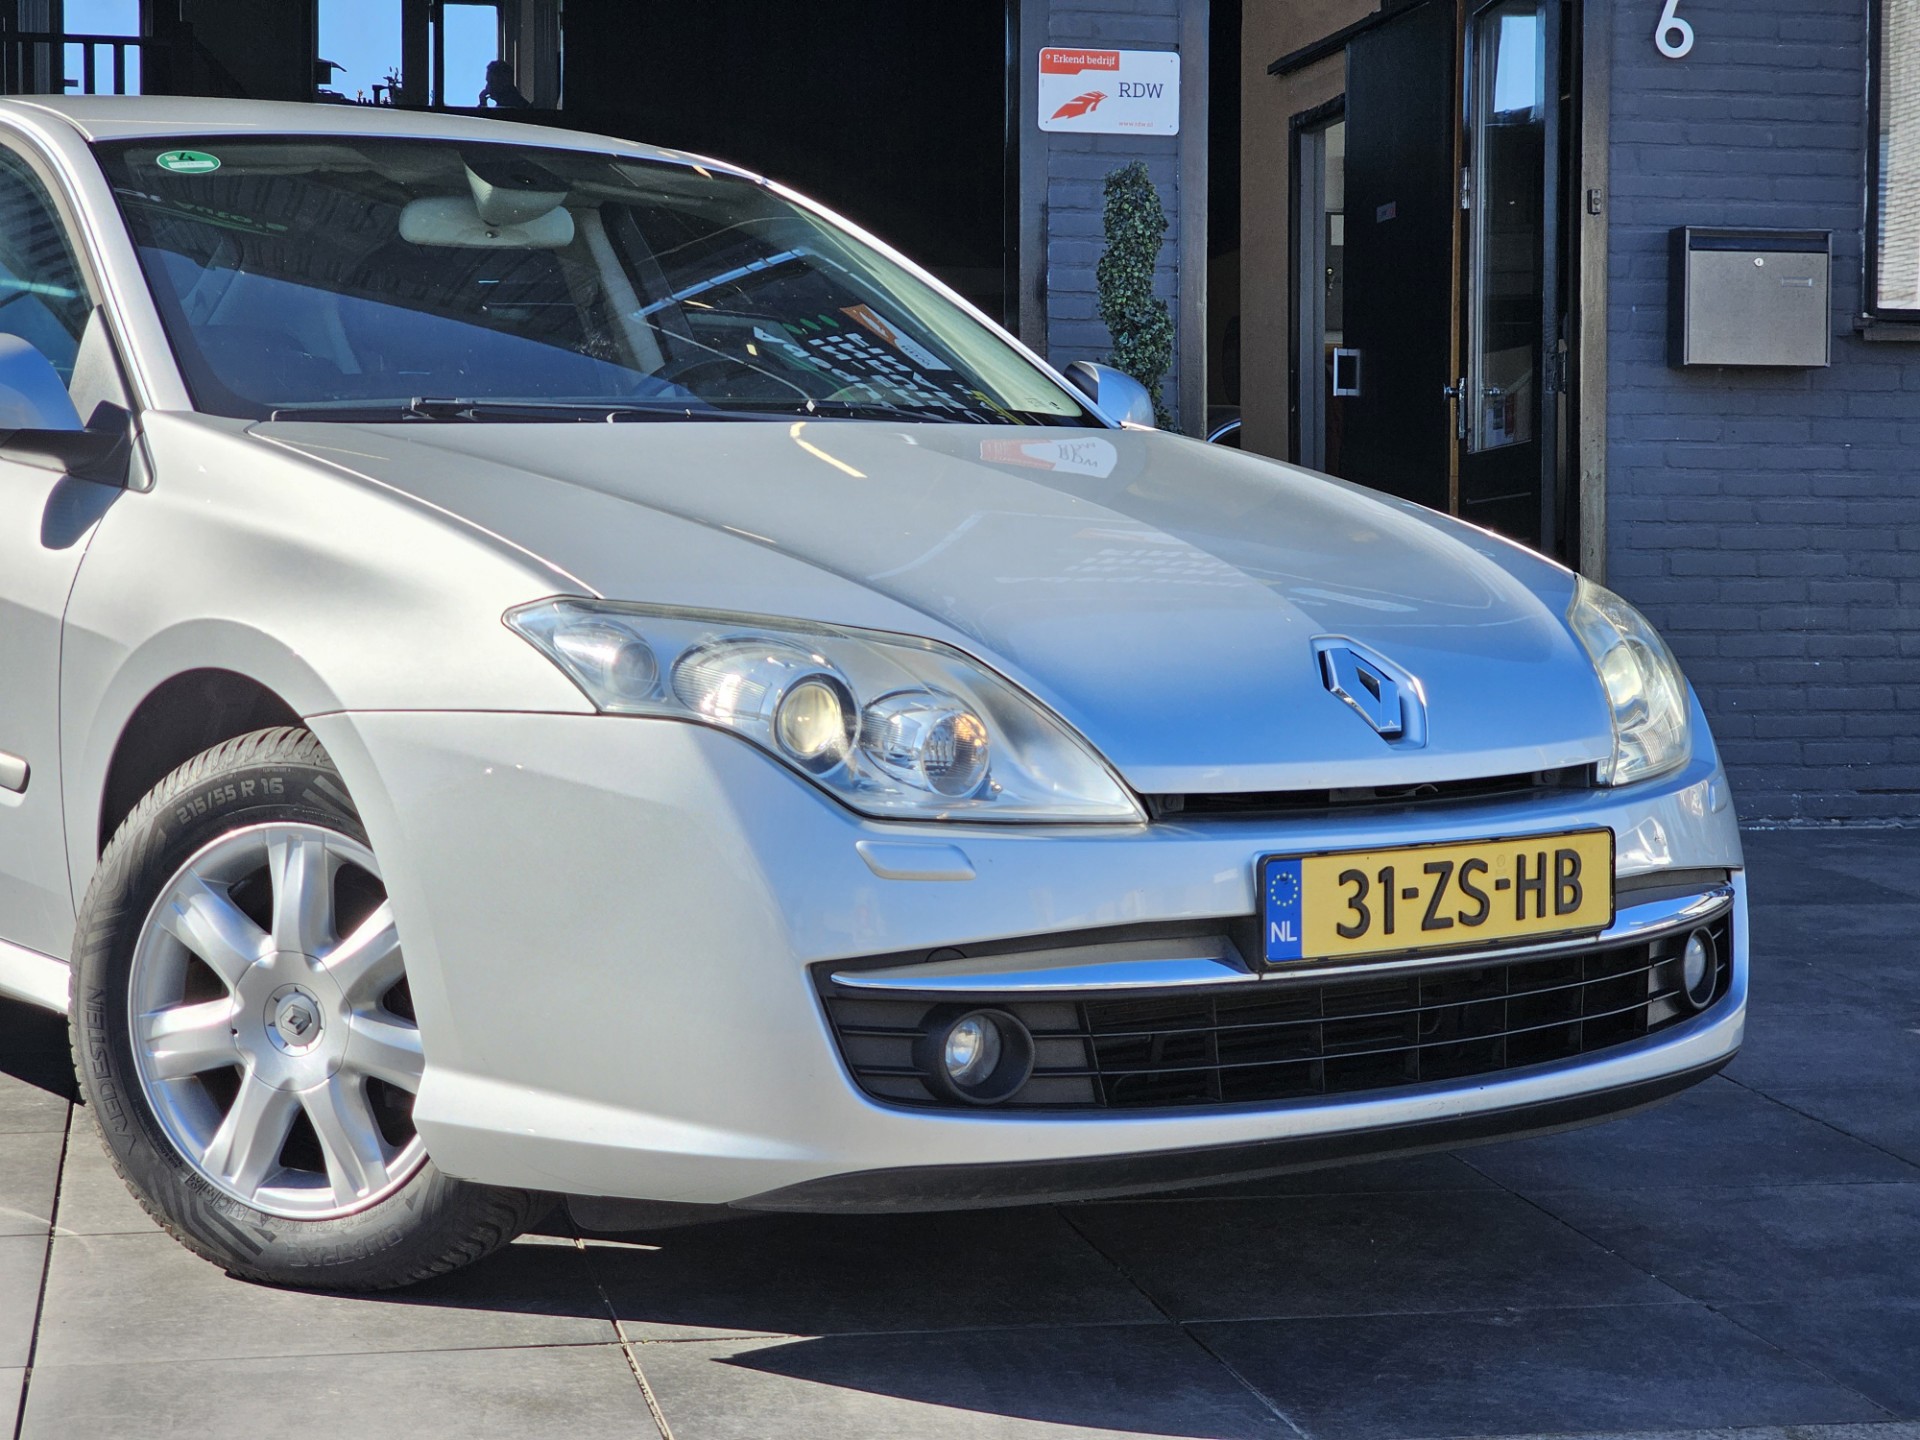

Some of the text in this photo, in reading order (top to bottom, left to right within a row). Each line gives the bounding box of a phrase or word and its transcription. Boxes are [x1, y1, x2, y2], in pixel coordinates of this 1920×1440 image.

[1655, 0, 1694, 59] 6
[1053, 54, 1116, 67] Erkend bedrijf
[1118, 81, 1164, 99] RDW
[176, 783, 237, 825] 215/55
[240, 779, 255, 798] R
[260, 777, 285, 795] 16
[1336, 848, 1583, 939] 31-ZS-HB
[1270, 920, 1298, 943] NL
